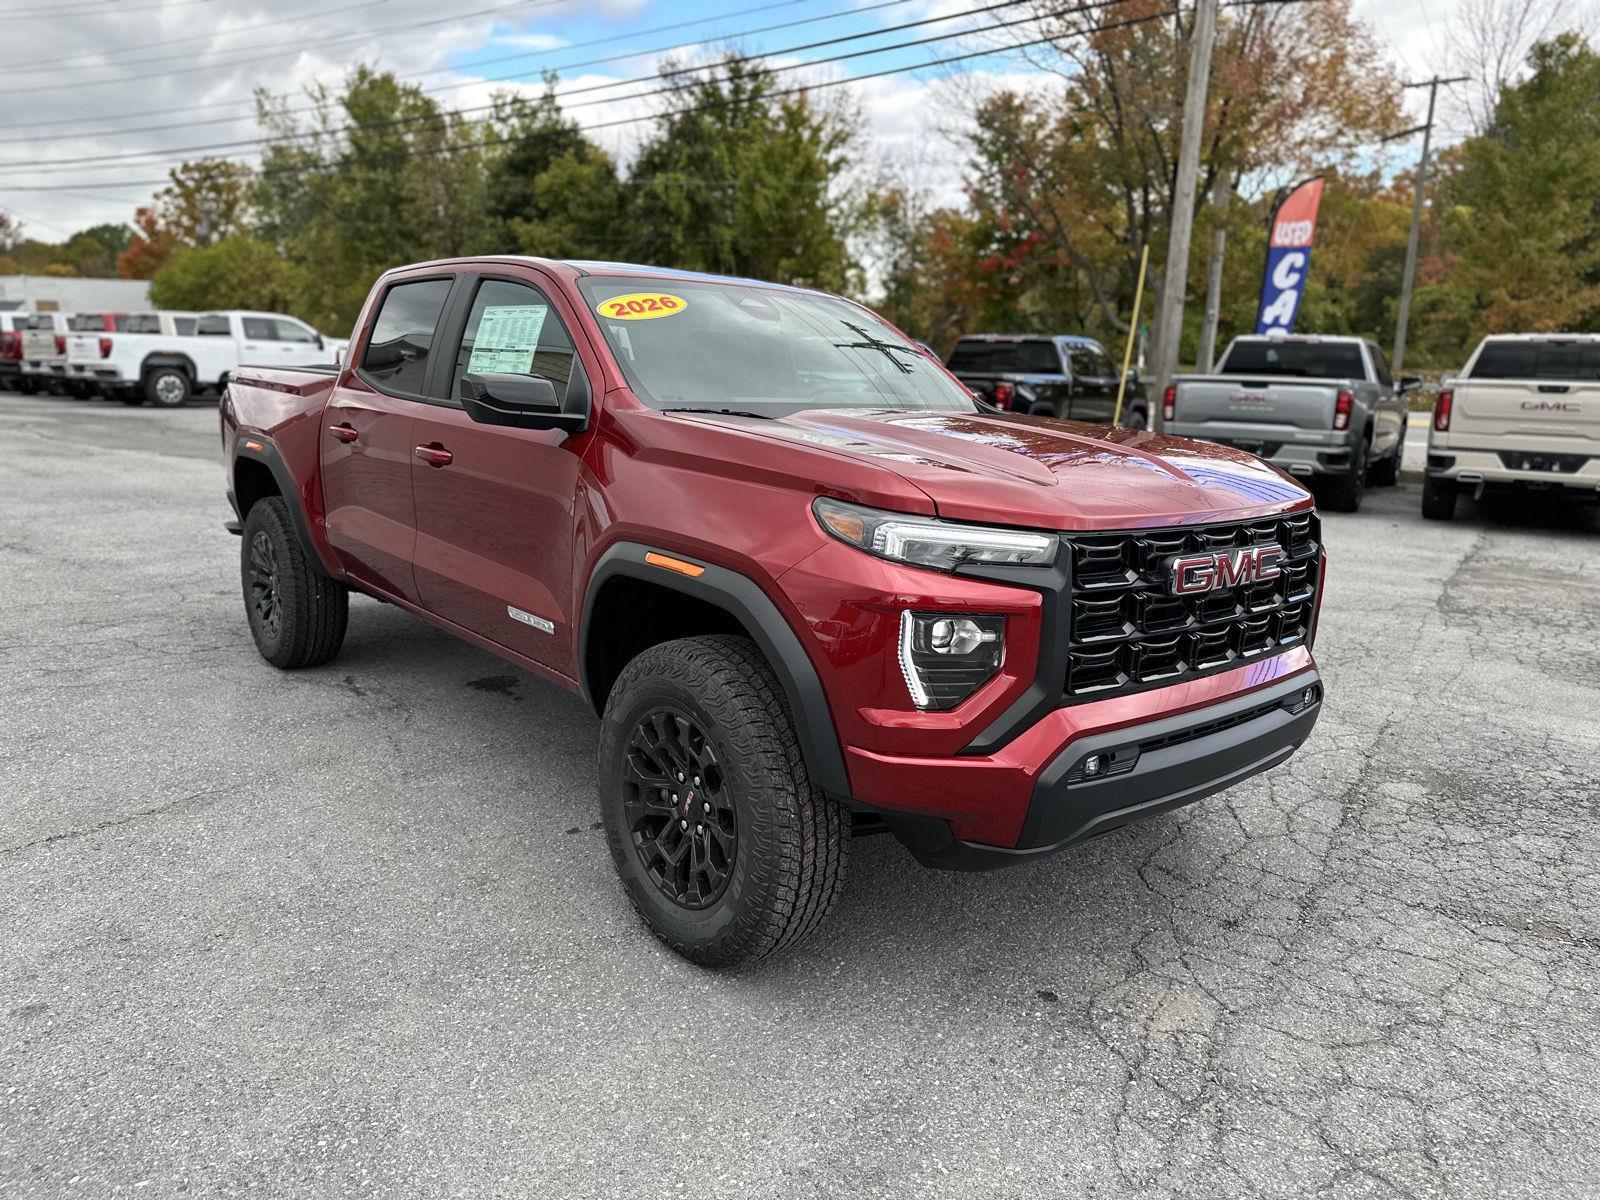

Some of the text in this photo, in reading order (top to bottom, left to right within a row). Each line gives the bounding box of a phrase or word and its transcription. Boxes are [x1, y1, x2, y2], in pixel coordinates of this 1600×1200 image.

[1275, 220, 1312, 244] USED
[609, 296, 678, 317] 2026
[1520, 401, 1582, 412] GMC
[1172, 545, 1283, 596] GMC
